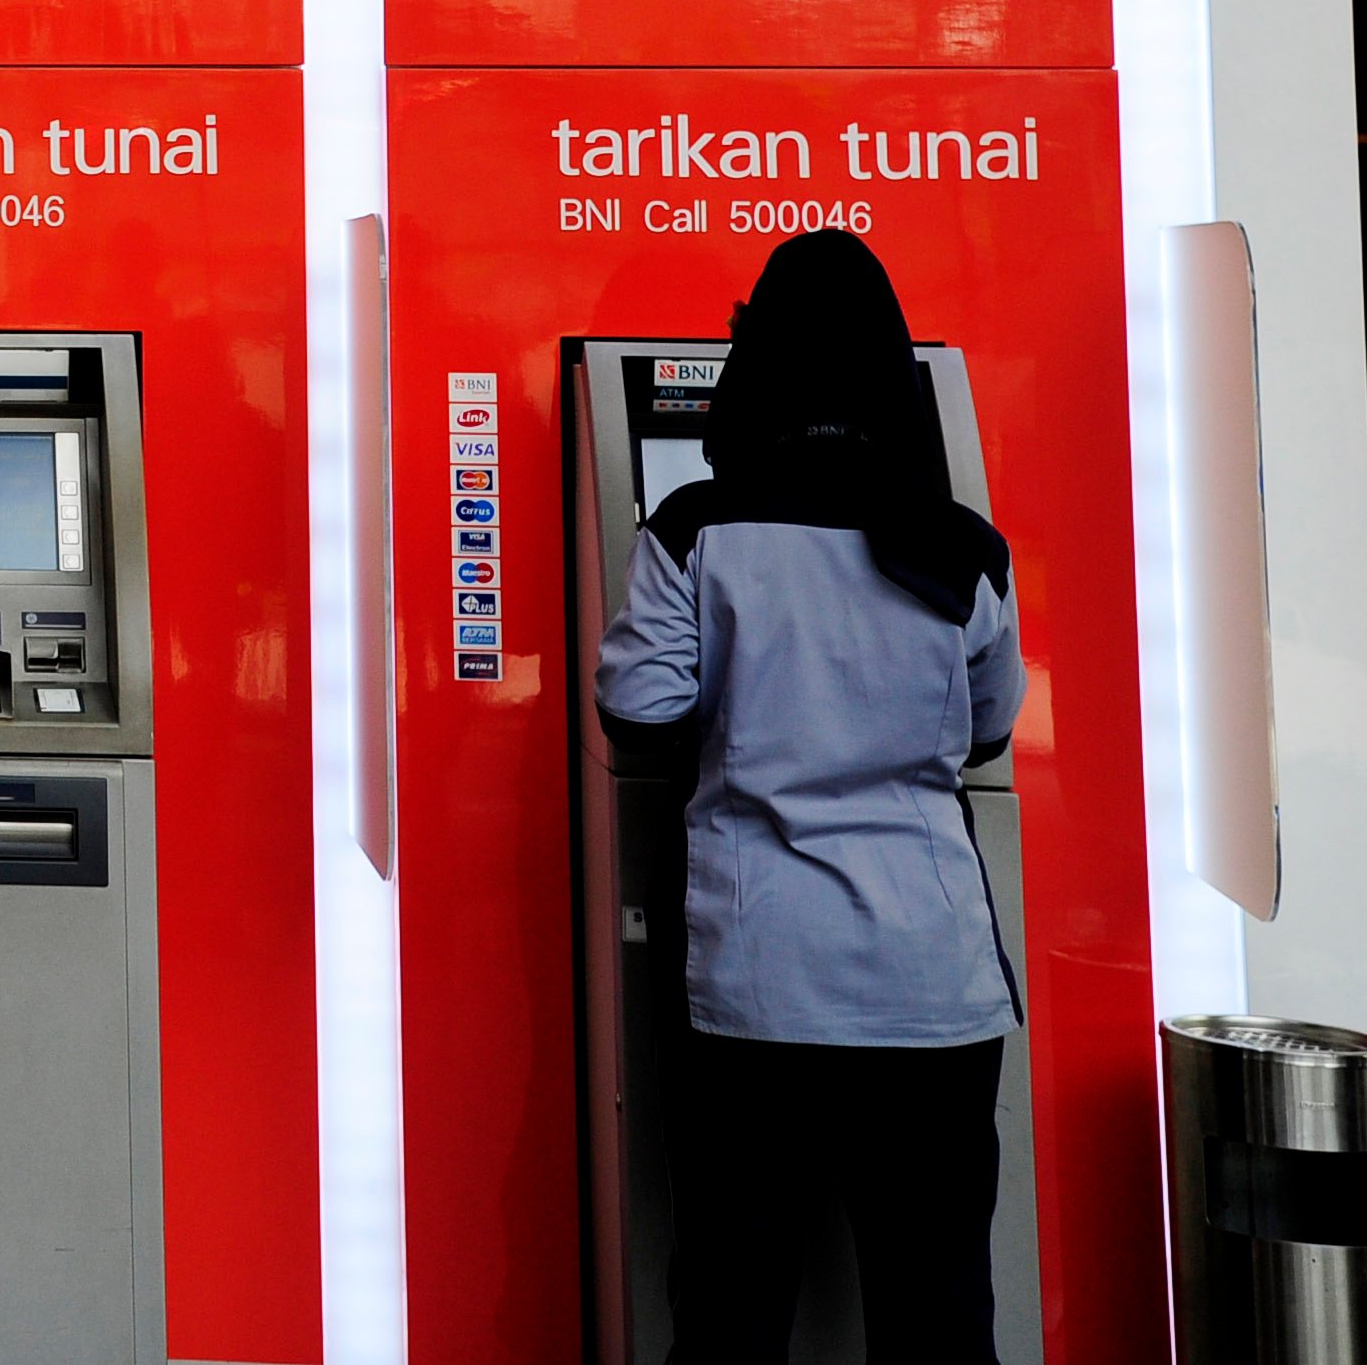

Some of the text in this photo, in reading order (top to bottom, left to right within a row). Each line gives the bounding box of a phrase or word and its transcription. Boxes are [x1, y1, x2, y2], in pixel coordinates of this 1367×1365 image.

[42, 114, 218, 176] tunai
[551, 114, 1038, 181] tarikan tunai
[559, 199, 873, 234] BNI Call 500046
[679, 364, 714, 381] BNI
[468, 379, 491, 389] BNI
[659, 388, 684, 398] ATM
[456, 442, 494, 456] VISA
